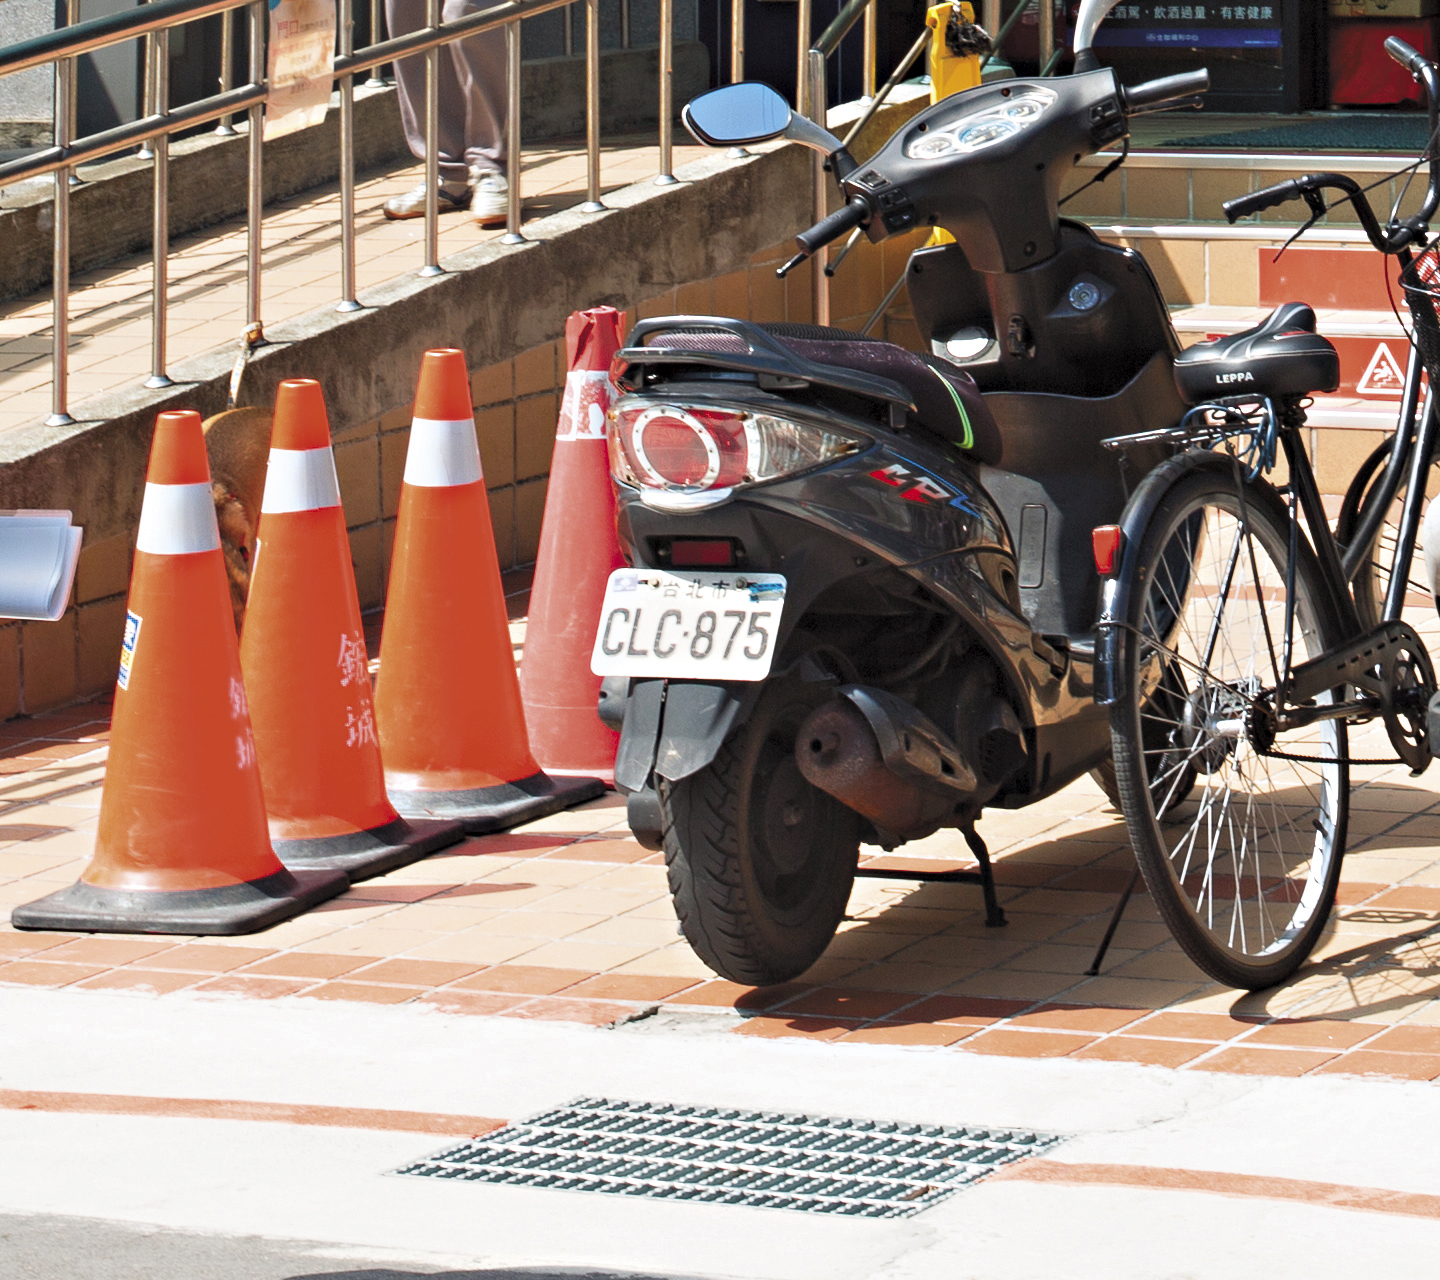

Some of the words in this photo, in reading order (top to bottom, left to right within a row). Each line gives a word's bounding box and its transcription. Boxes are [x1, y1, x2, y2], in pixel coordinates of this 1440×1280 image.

[1215, 372, 1254, 385] LEPPA
[663, 578, 730, 600] 台北市
